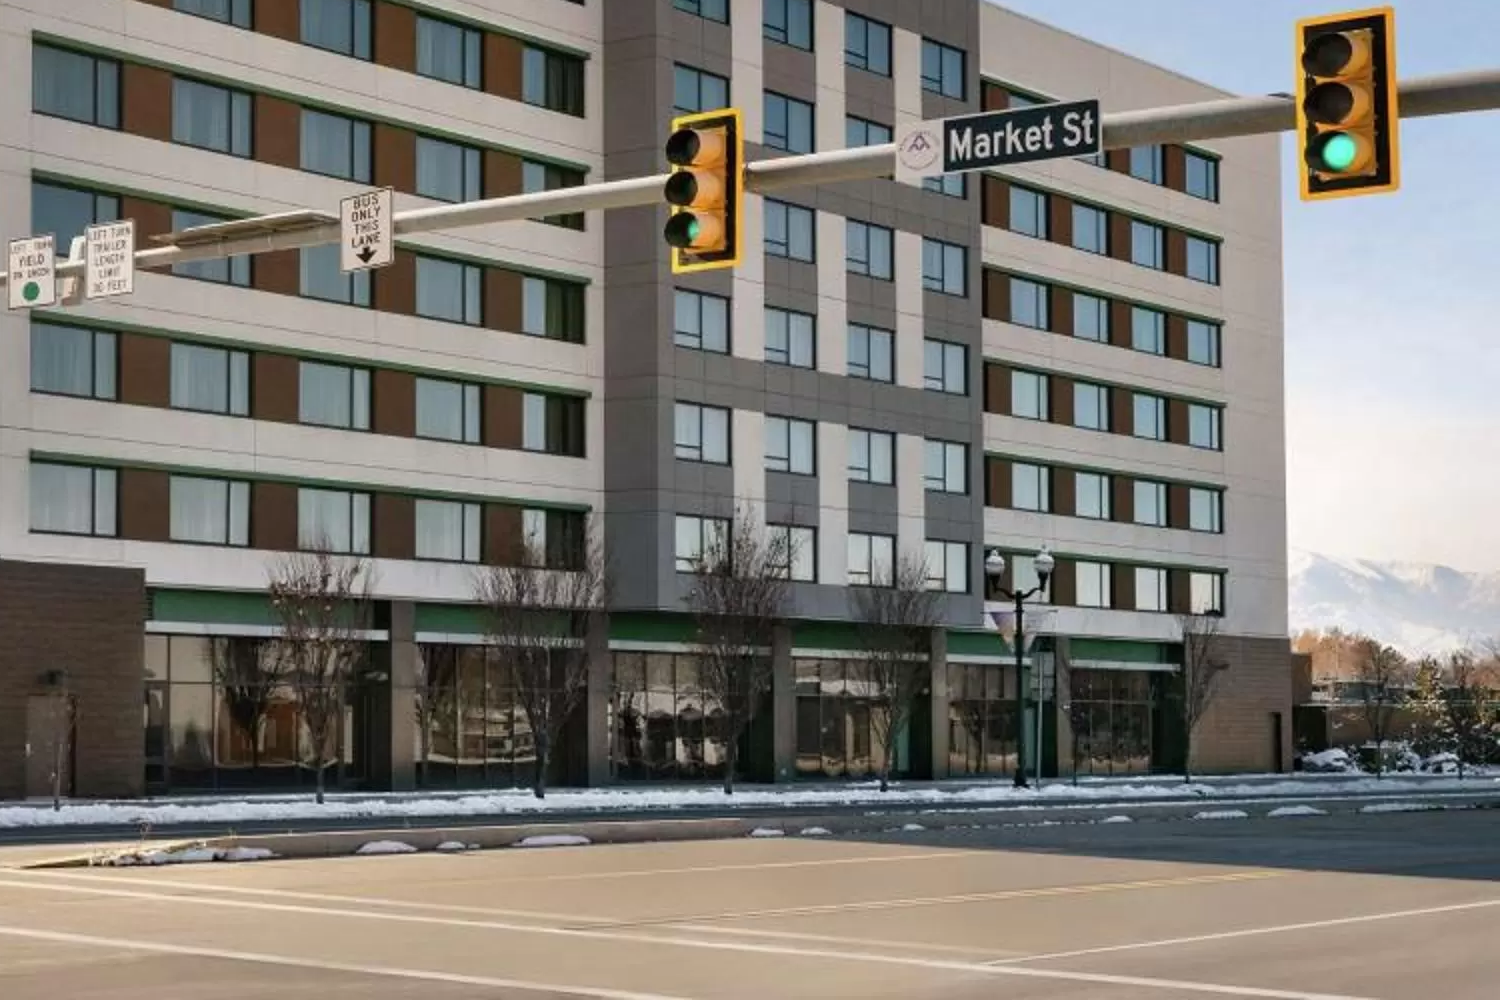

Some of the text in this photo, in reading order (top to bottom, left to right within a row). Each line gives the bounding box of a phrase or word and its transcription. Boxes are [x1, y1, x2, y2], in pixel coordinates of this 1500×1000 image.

[950, 115, 1053, 163] Market
[1062, 110, 1095, 148] St
[353, 192, 379, 210] BUS
[351, 206, 381, 223] ONLY
[351, 232, 380, 248] LANE
[18, 253, 45, 268] YIELD
